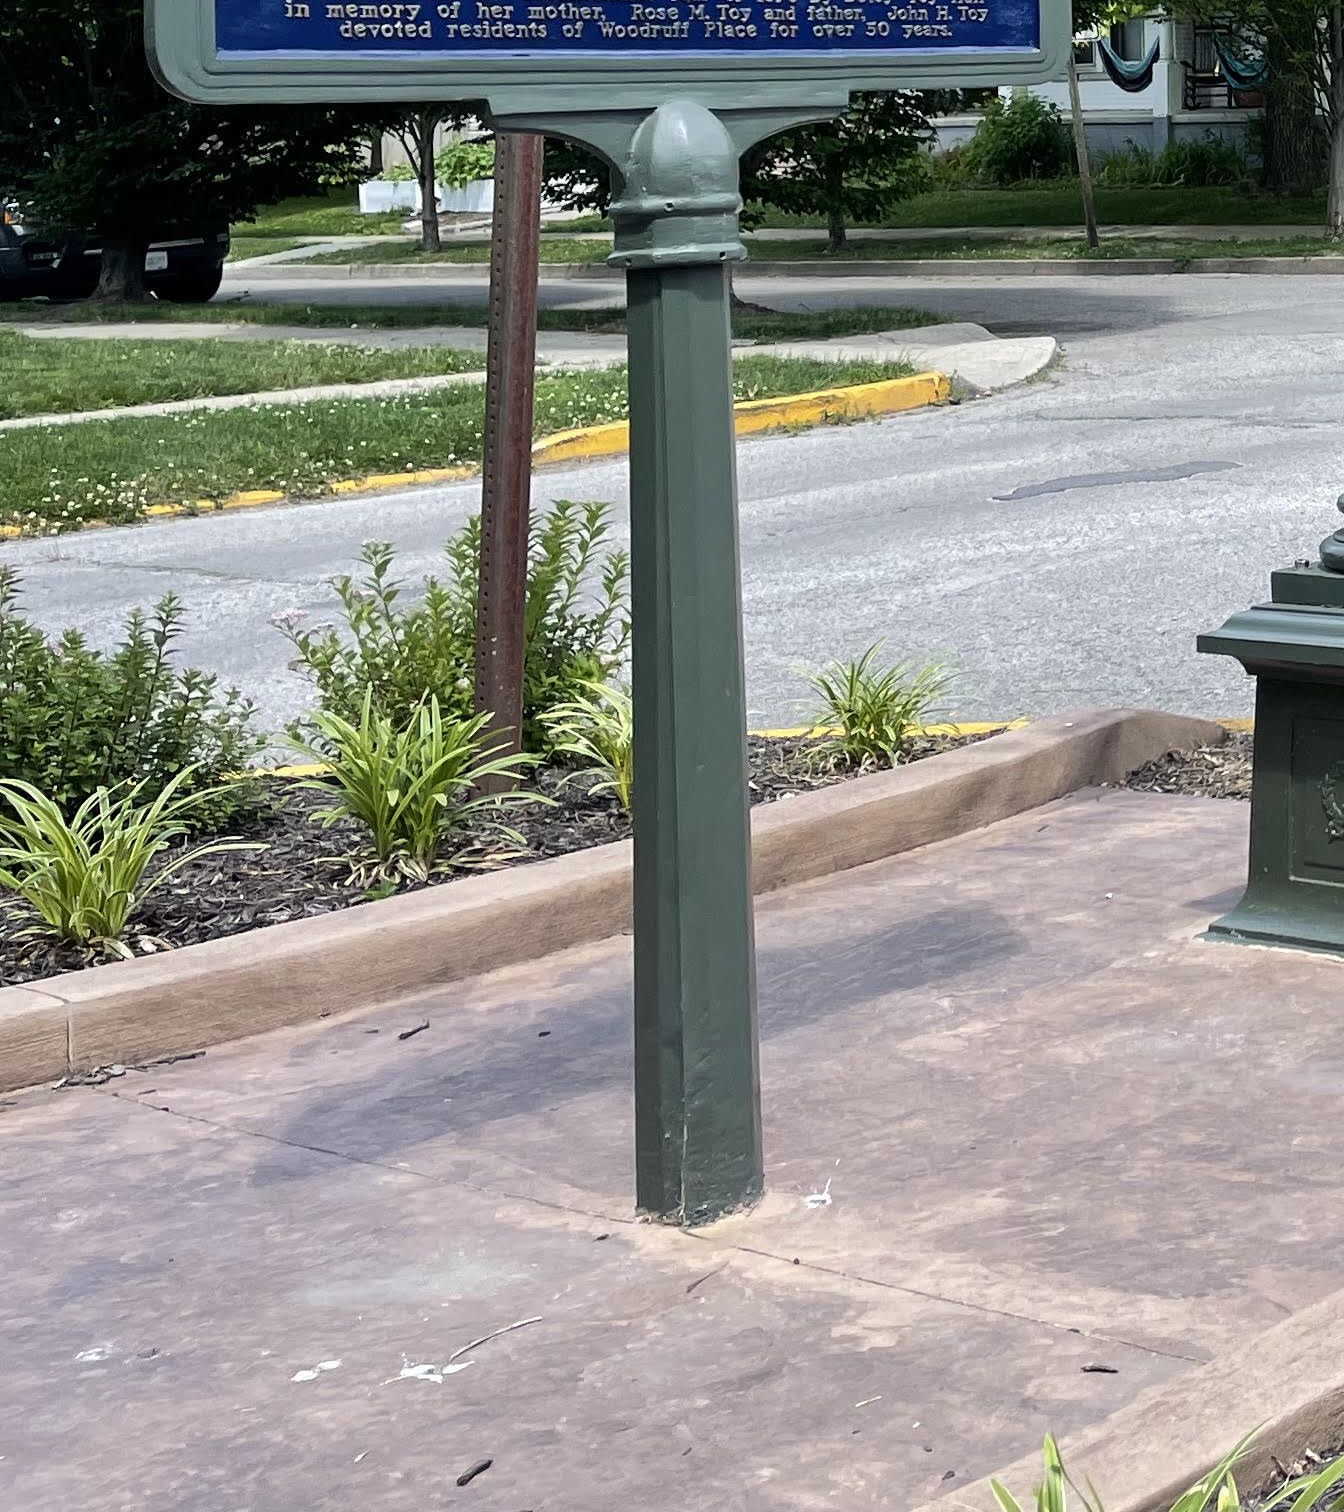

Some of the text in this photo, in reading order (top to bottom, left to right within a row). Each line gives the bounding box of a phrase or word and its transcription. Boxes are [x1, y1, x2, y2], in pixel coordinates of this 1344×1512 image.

[326, 3, 421, 21] memory
[437, 0, 461, 19] of
[476, 0, 514, 19] her
[632, 2, 679, 20] Rose
[716, 3, 752, 22] Toy
[764, 4, 796, 21] and
[888, 4, 929, 21] John
[958, 4, 989, 22] Toy
[340, 19, 432, 38] devoted
[447, 19, 547, 38] residents
[563, 20, 584, 38] of
[598, 20, 690, 38] Woodruff
[705, 20, 757, 38] Place
[771, 20, 799, 38] for
[813, 23, 855, 37] over
[866, 20, 890, 37] 50
